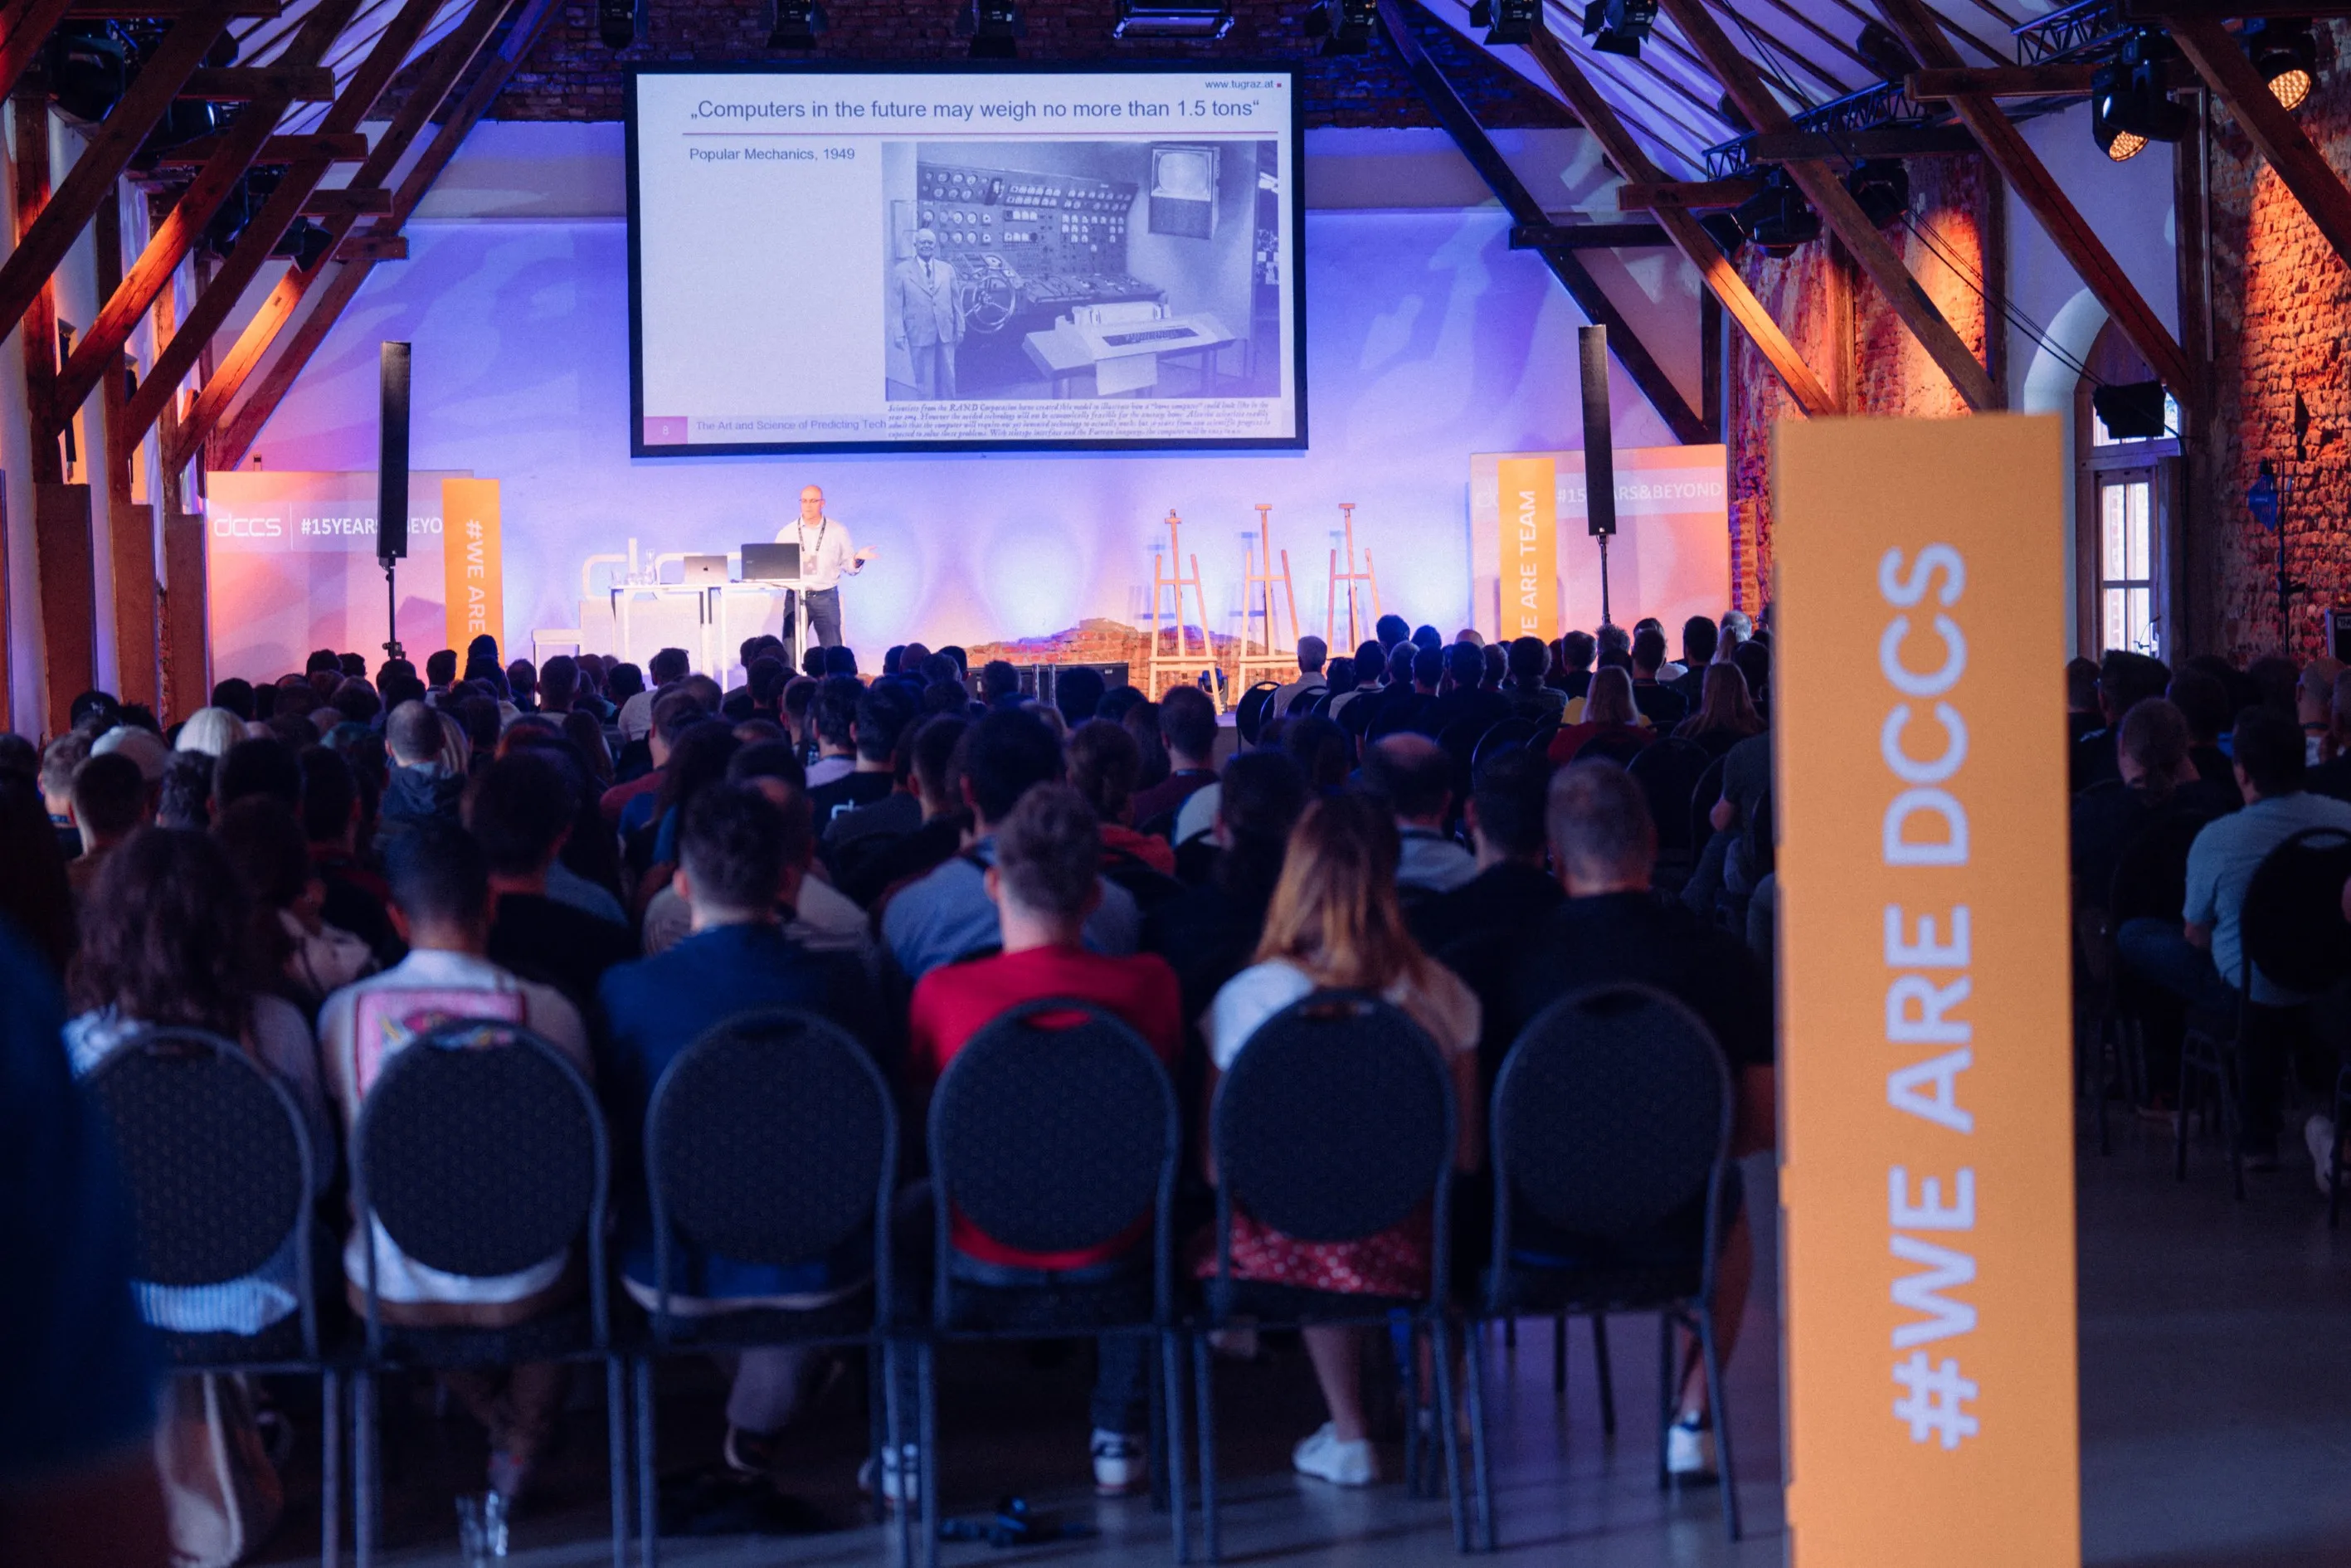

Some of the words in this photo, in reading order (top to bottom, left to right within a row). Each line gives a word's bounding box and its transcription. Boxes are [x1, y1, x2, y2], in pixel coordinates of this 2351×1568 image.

[1205, 80, 1274, 90] www.tugraz.at
[690, 100, 806, 121] „Computers
[812, 100, 829, 117] in
[835, 100, 865, 117] the
[871, 100, 927, 118] future
[933, 104, 974, 121] may
[980, 101, 1037, 122] weigh
[1043, 105, 1067, 117] no
[1073, 104, 1122, 117] more
[1128, 100, 1170, 117] than
[1178, 100, 1206, 117] 1.5
[689, 149, 741, 163] Popular
[745, 148, 818, 161] Mechanics,
[824, 148, 855, 160] 1949
[696, 421, 715, 431] The
[718, 421, 733, 431] Art
[735, 421, 753, 430] and
[757, 421, 795, 430] Science
[798, 420, 808, 429] of
[810, 419, 859, 431] Predicting
[214, 513, 282, 537] dccs
[1519, 490, 1536, 557] TEAM
[465, 519, 484, 579] #WE
[467, 586, 486, 633] ARE
[1521, 562, 1537, 610] ARE
[1877, 541, 1970, 868] DCCS
[1883, 902, 1974, 1136] ARE
[1888, 1164, 1980, 1452] #WE
